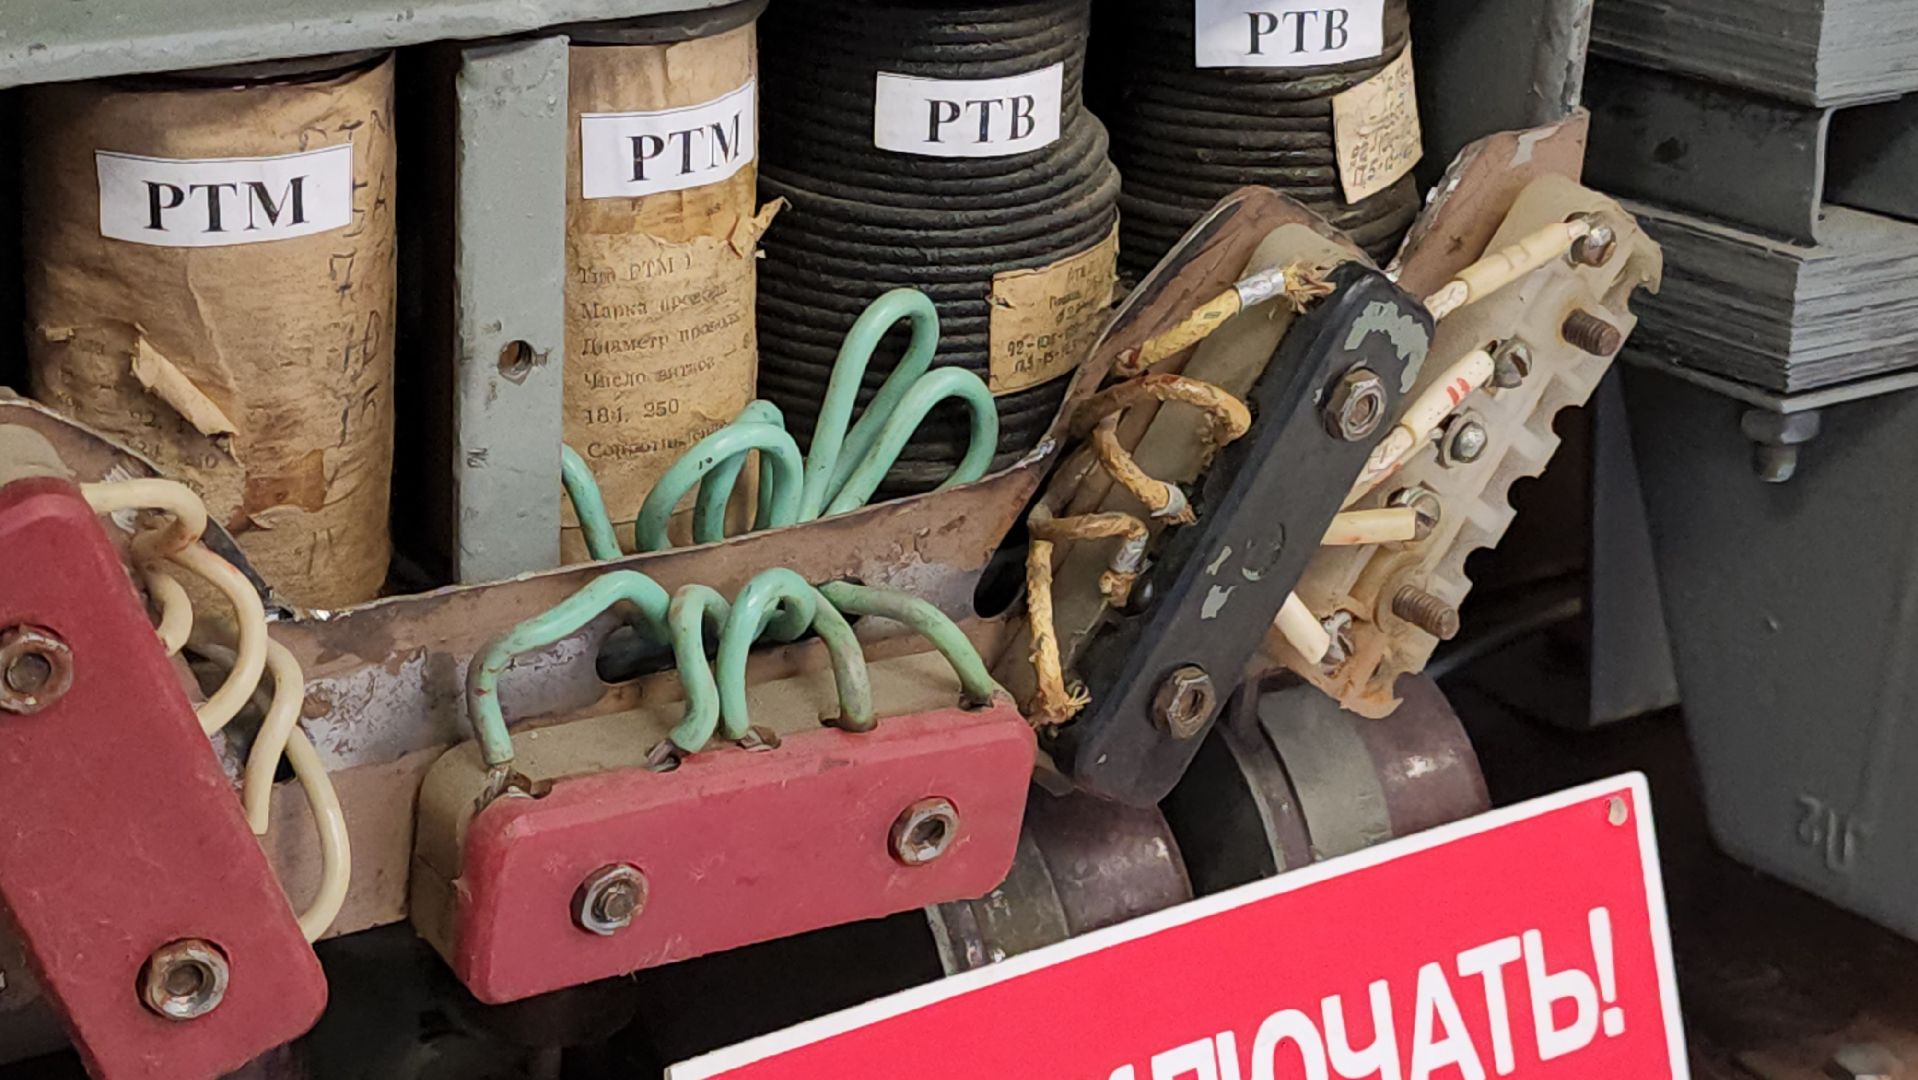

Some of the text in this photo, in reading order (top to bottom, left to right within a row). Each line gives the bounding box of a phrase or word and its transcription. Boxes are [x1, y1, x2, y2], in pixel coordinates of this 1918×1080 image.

[1243, 8, 1349, 55] РТВ
[923, 94, 1036, 144] РТВ
[625, 110, 743, 183] РТМ
[140, 174, 311, 233] РТМ
[581, 301, 648, 321] Марка
[581, 332, 669, 357] Диаметр
[584, 368, 648, 391] Число
[643, 398, 679, 418] 250
